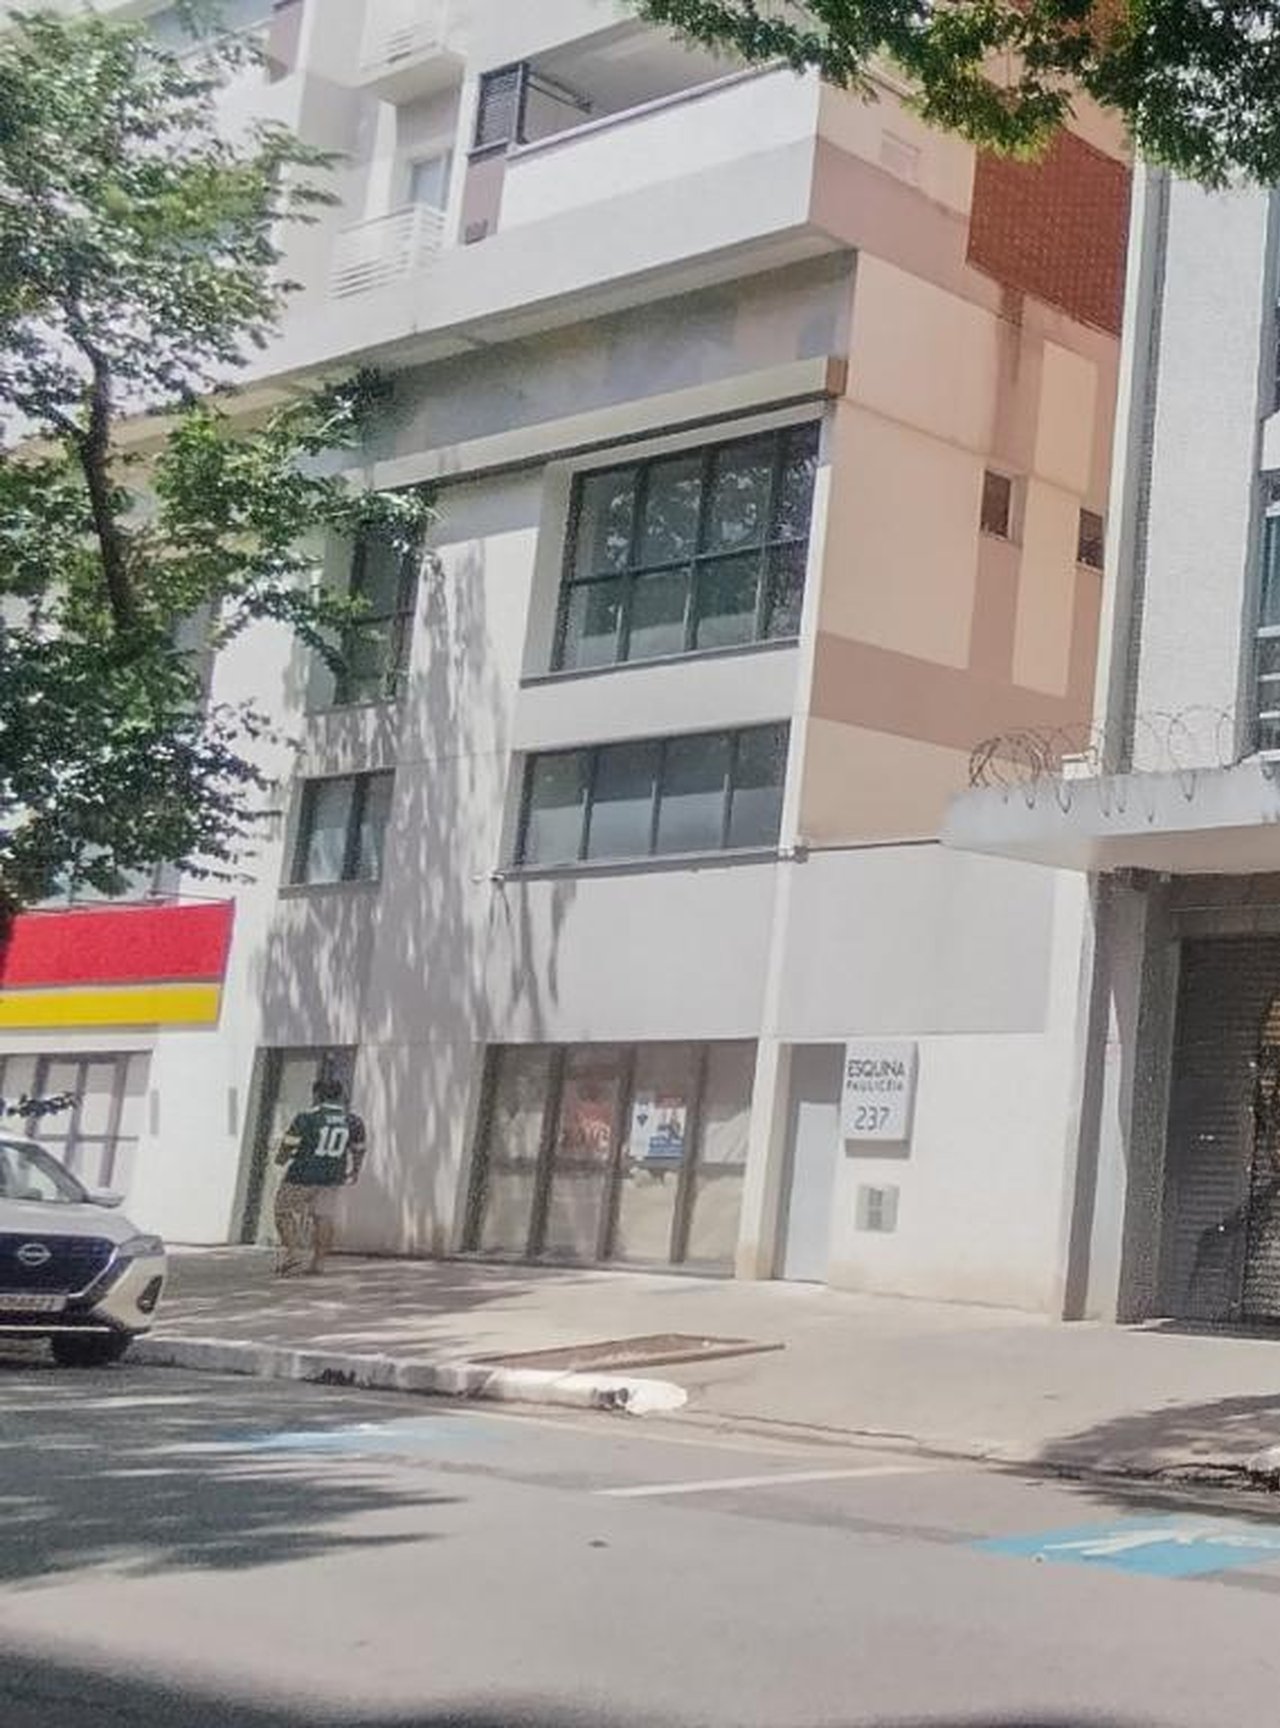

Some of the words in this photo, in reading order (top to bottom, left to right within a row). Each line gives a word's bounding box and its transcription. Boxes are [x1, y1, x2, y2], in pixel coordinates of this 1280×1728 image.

[847, 1059, 905, 1078] ESQUINA
[854, 1106, 890, 1131] 237
[314, 1126, 350, 1157] 10
